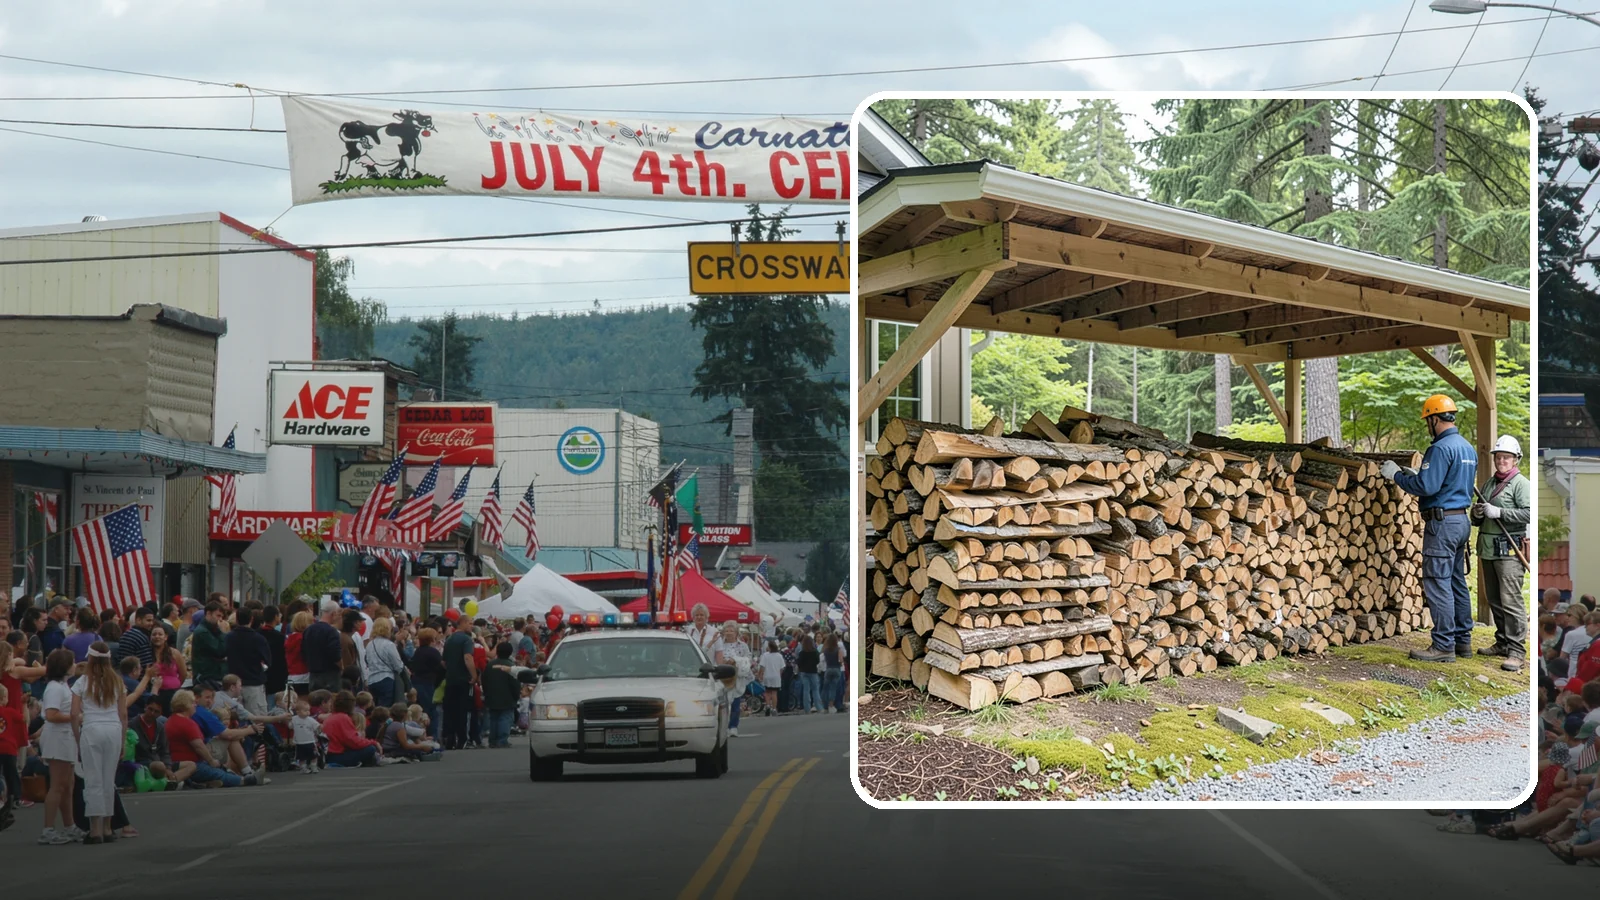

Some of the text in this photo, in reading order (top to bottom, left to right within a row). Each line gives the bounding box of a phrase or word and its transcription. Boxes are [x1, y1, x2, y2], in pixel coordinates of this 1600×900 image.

[481, 141, 604, 192] JULY
[632, 150, 746, 198] 4th.
[697, 254, 849, 280] CROSSWA
[283, 380, 373, 420] ACE
[405, 409, 485, 421] CEDAR LOG
[284, 421, 371, 436] Hardware
[416, 428, 477, 447] Coca-Cola
[95, 485, 124, 495] Vincent
[126, 486, 135, 495] de
[137, 486, 155, 495] Paul
[688, 526, 741, 535] CRNATION
[699, 535, 730, 543] GLASS
